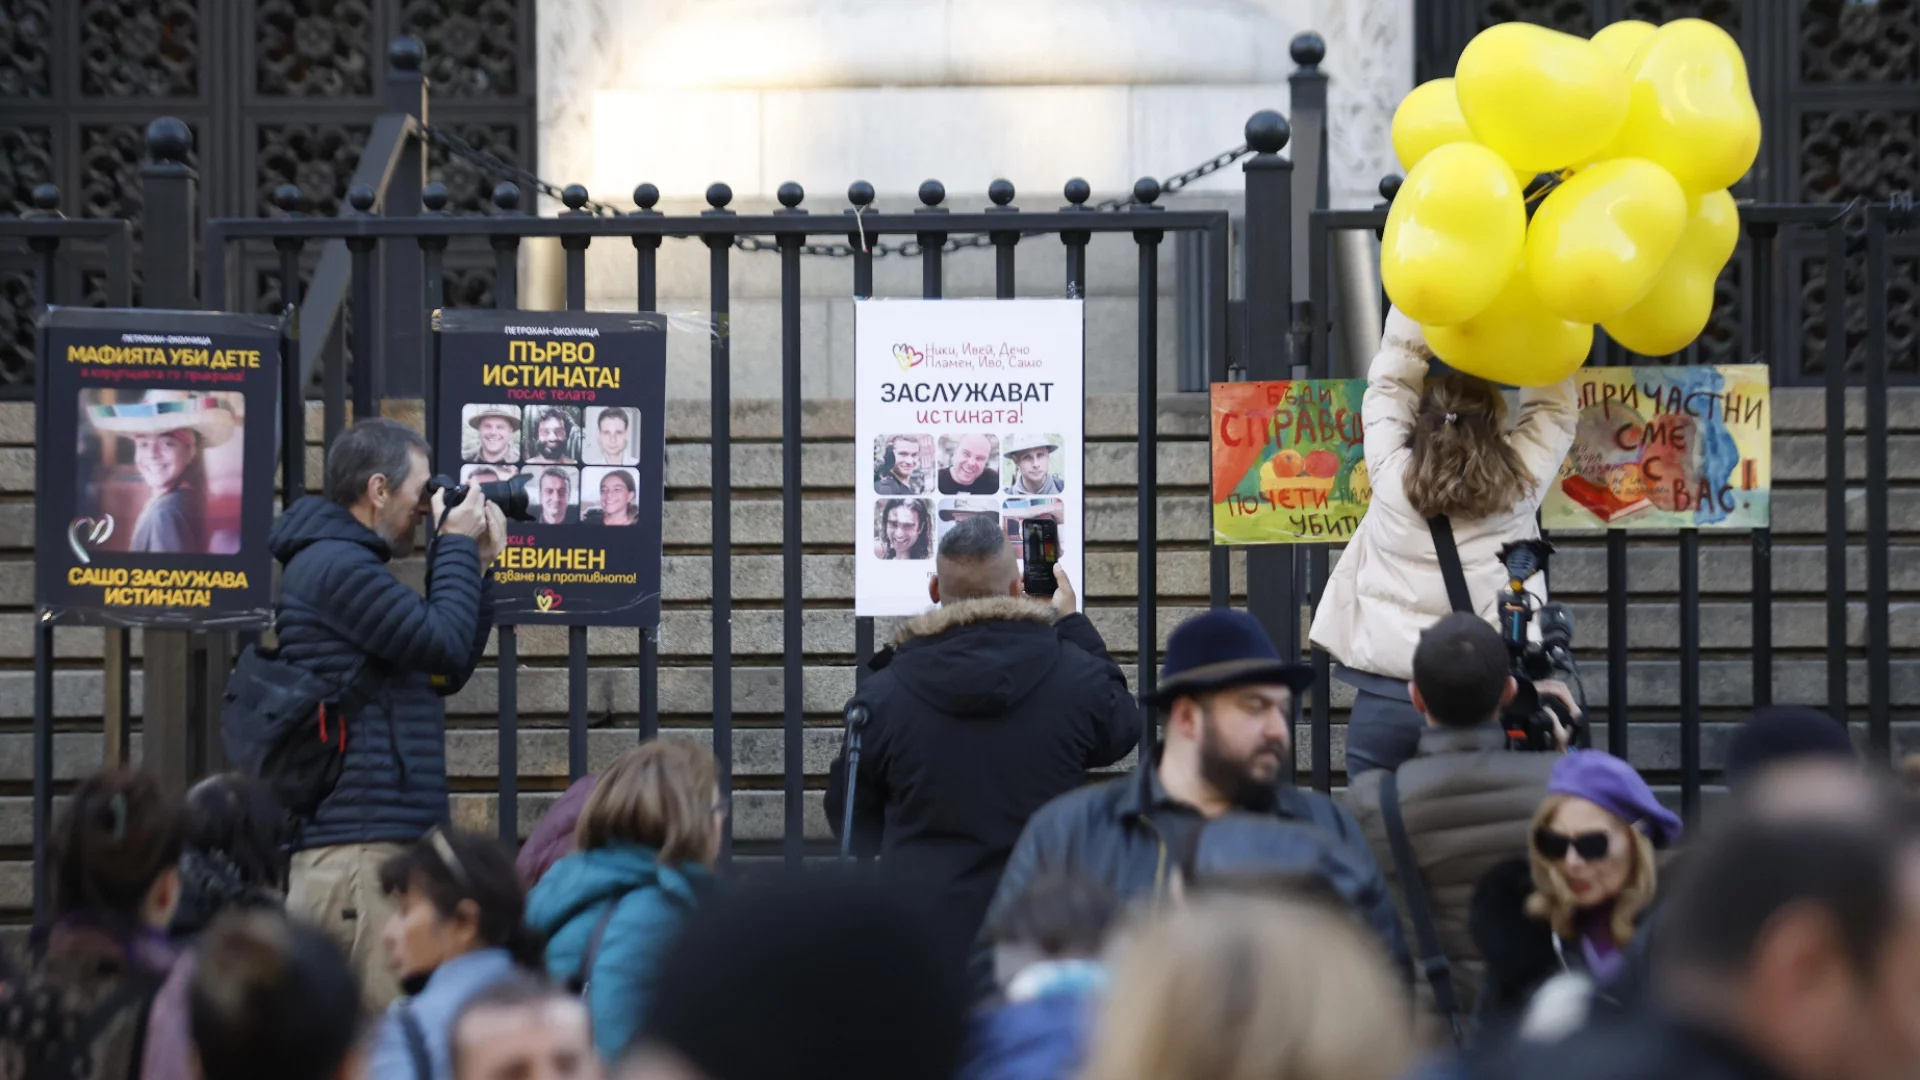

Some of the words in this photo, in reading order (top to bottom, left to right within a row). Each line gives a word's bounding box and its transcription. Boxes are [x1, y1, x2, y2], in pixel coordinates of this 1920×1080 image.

[504, 326, 600, 338] ПЕТРОХАН-ОКОЛЧИЦА
[67, 345, 168, 365] МАФИЯТА
[169, 348, 209, 366] УБИ
[209, 350, 260, 369] ДЕТЕ
[509, 340, 596, 364] ПЪРВО
[925, 343, 958, 357] Ники,
[961, 343, 996, 357] Ивей,
[999, 342, 1030, 356] Дечо
[925, 355, 975, 370] Пламен,
[978, 356, 1005, 370] Иво,
[1008, 356, 1043, 368] Сашо
[482, 364, 621, 389] ИСТИНАТА!
[507, 388, 547, 400] после
[550, 389, 596, 402] телата
[880, 383, 1054, 403] ЗАСЛУЖАВАТ
[916, 402, 1024, 424] истината!
[1577, 382, 1763, 430] ПРИЧАСТНИ
[1220, 408, 1364, 450] СПРАВЕД
[1616, 421, 1688, 451] СМЕ
[1642, 456, 1663, 481] С
[1227, 487, 1329, 517] ПОЧЕТИ
[506, 535, 524, 545] ки
[527, 535, 536, 546] е
[489, 547, 606, 570] НЕВИНЕН
[68, 567, 129, 586] САШО
[130, 569, 249, 589] ЗАСЛУЖАВА
[494, 569, 535, 584] азване
[536, 573, 551, 582] на
[553, 571, 637, 584] противното!
[104, 587, 212, 607] ИСТИНАТА!
